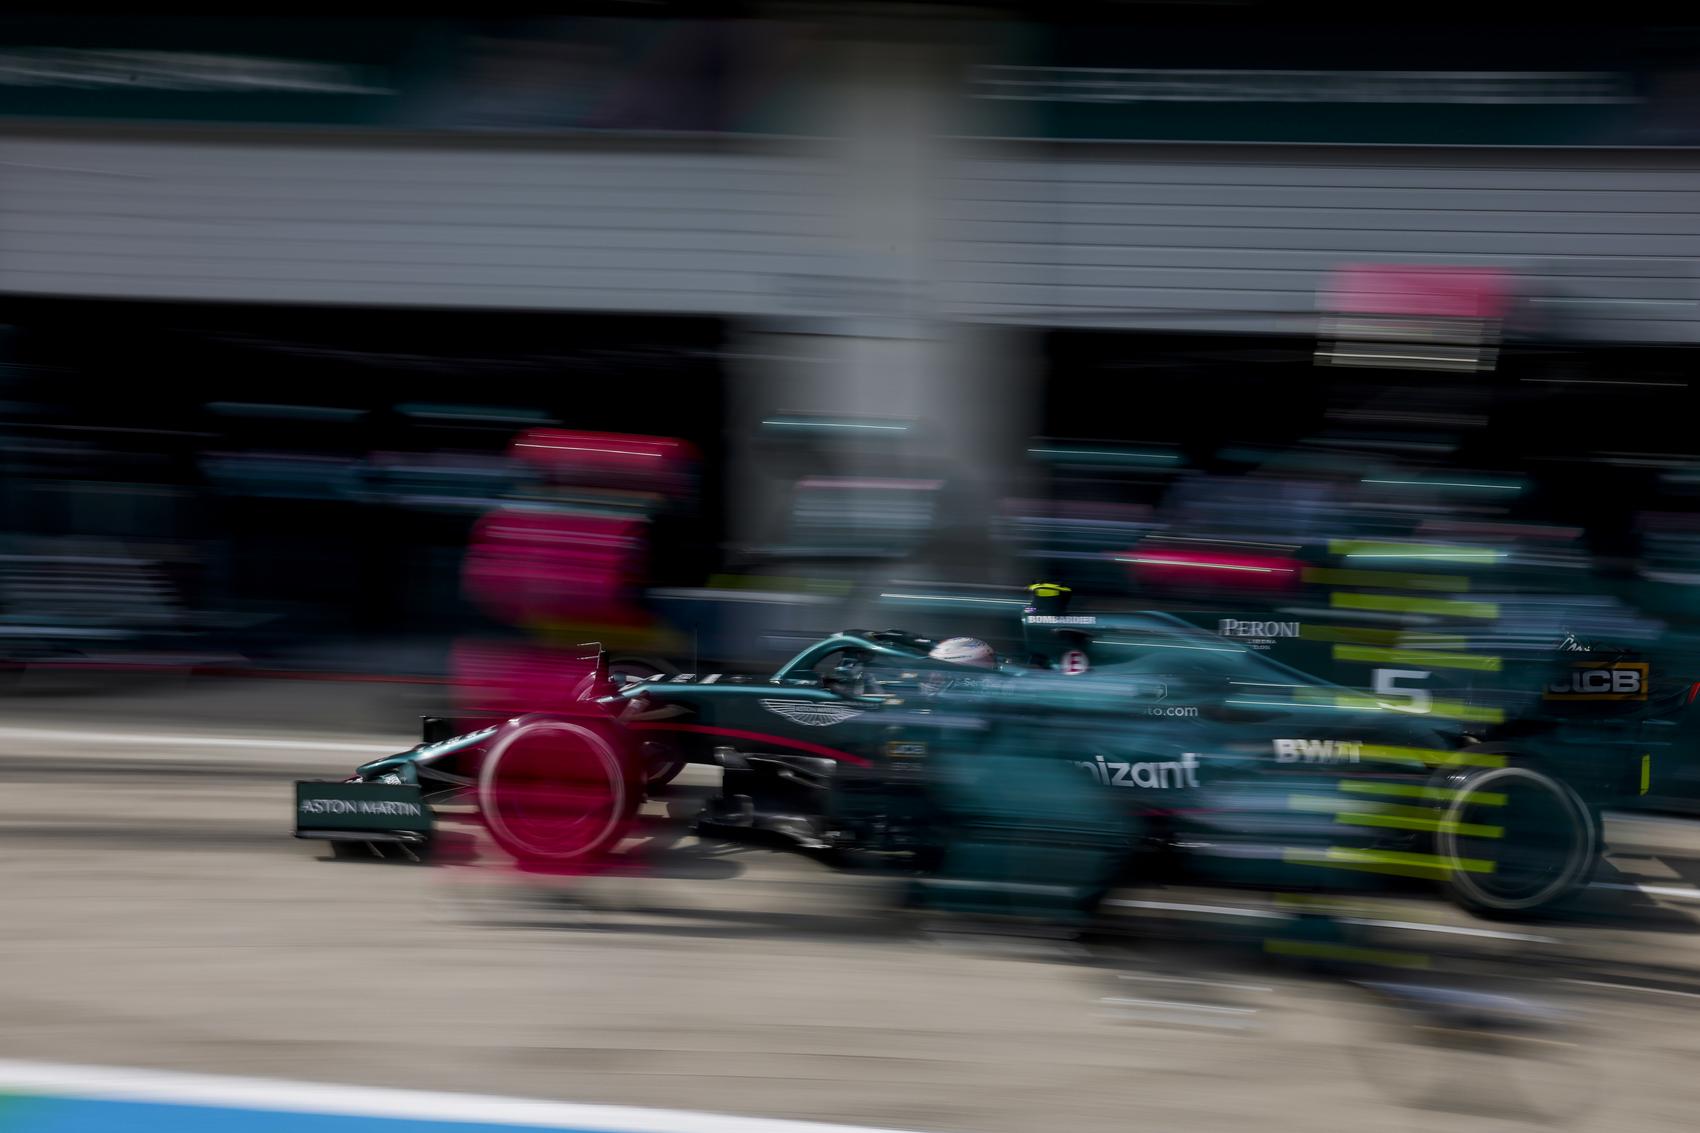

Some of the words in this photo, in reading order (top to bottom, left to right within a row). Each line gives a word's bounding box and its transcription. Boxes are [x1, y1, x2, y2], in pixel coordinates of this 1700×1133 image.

[1219, 618, 1300, 637] PERONI
[1372, 668, 1433, 714] 5
[1143, 706, 1199, 717] to.com
[1074, 752, 1200, 788] nizant
[303, 799, 357, 814] ASTON
[358, 800, 421, 816] MARTIN
